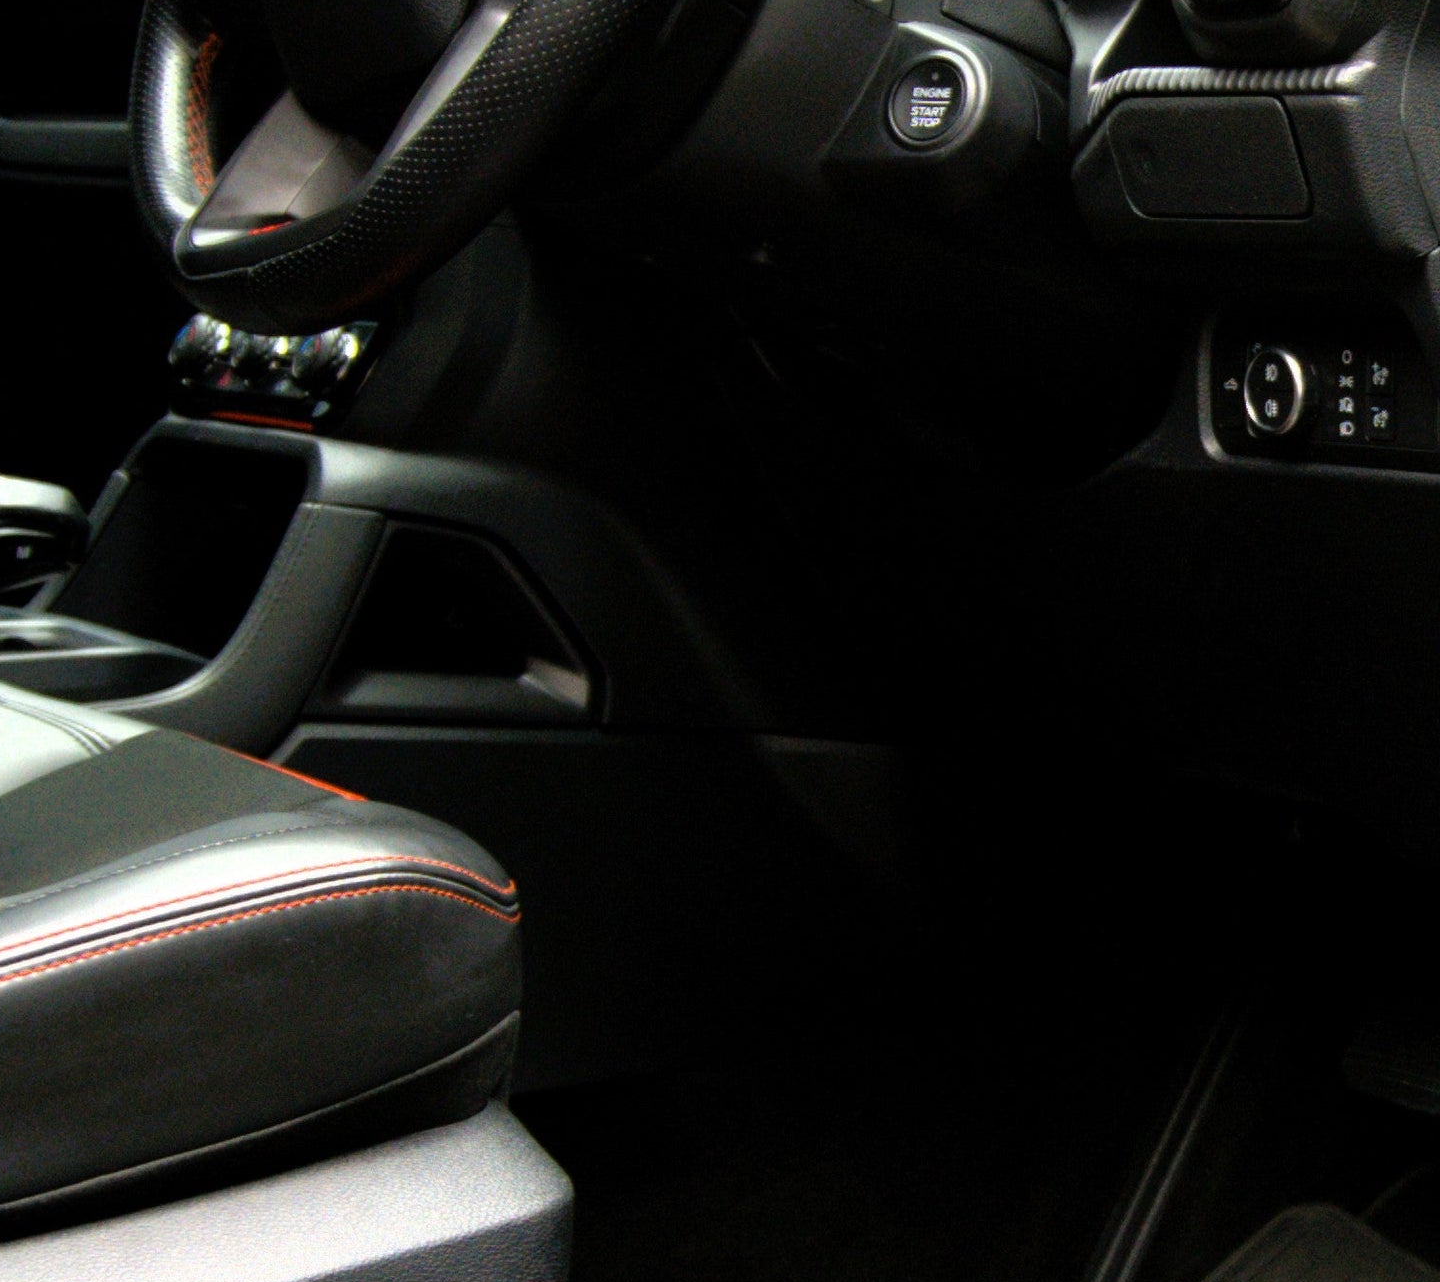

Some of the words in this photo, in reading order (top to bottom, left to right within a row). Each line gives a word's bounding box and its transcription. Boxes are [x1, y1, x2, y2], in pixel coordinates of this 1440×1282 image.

[912, 86, 952, 98] ENGINE
[910, 106, 947, 117] START
[910, 117, 941, 127] STOP
